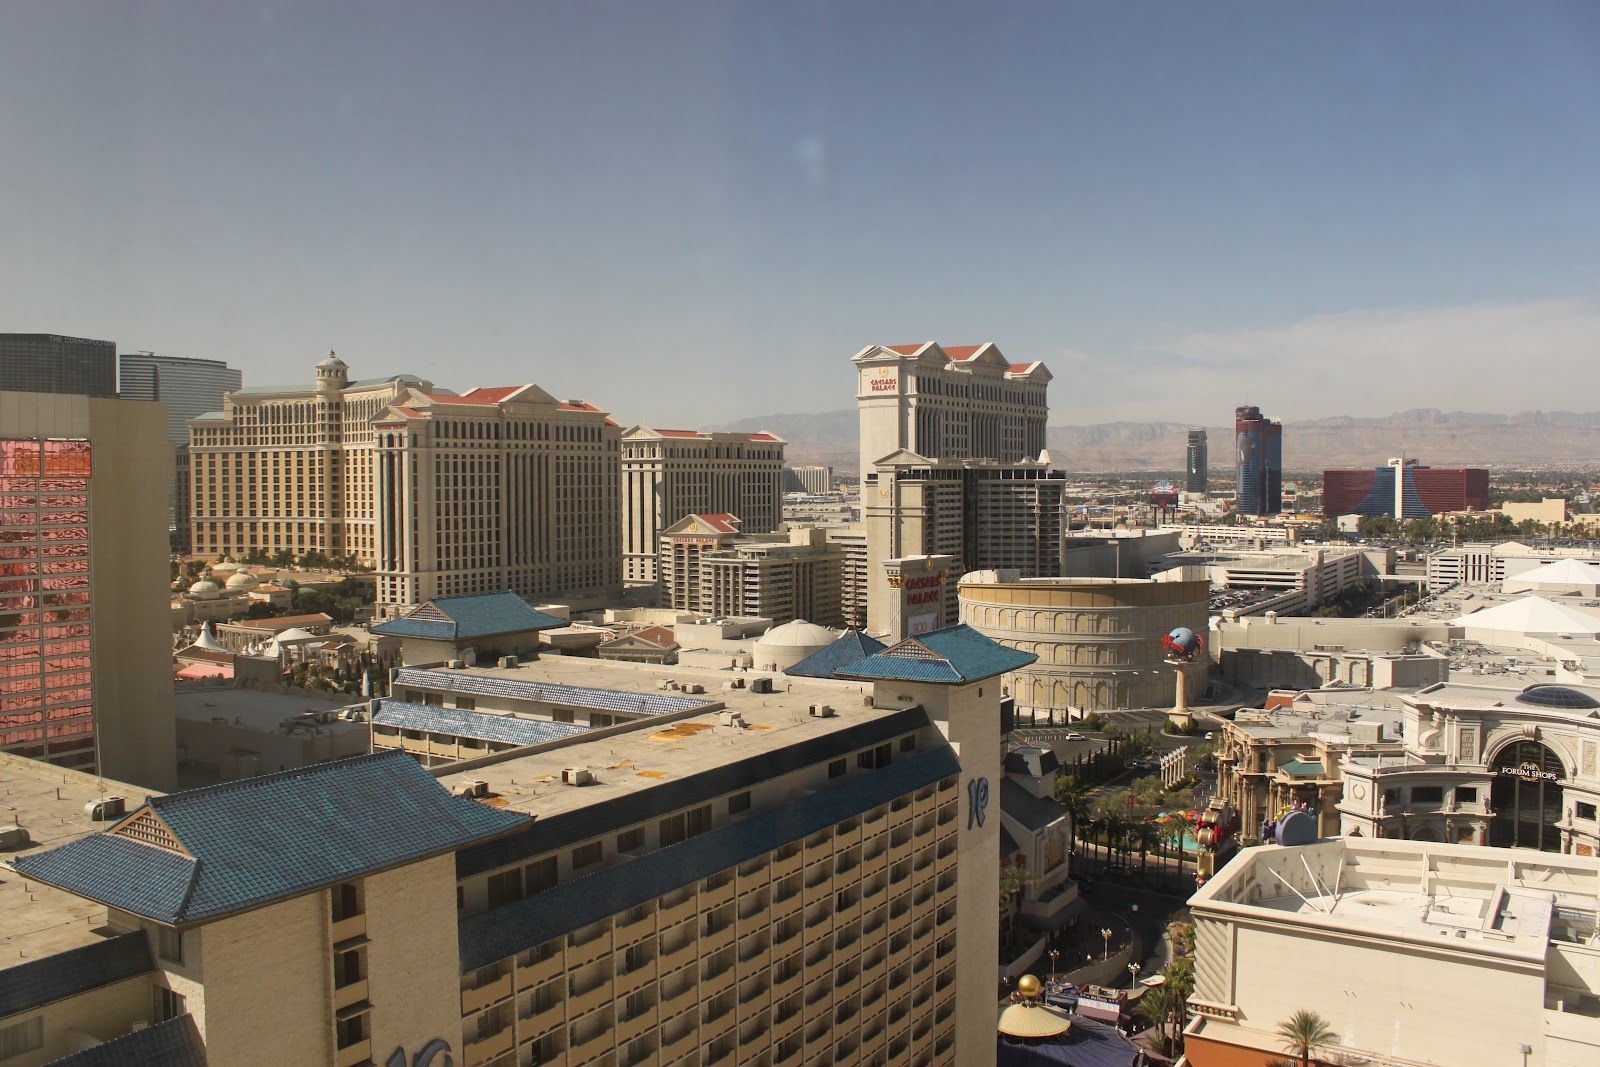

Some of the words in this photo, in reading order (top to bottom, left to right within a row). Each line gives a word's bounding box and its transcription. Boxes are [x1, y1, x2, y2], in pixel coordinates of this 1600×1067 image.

[49, 335, 63, 343] THE
[64, 337, 115, 347] COSMOPOLITAN
[1502, 767, 1530, 777] FORUM
[1531, 770, 1557, 780] SHOPS
